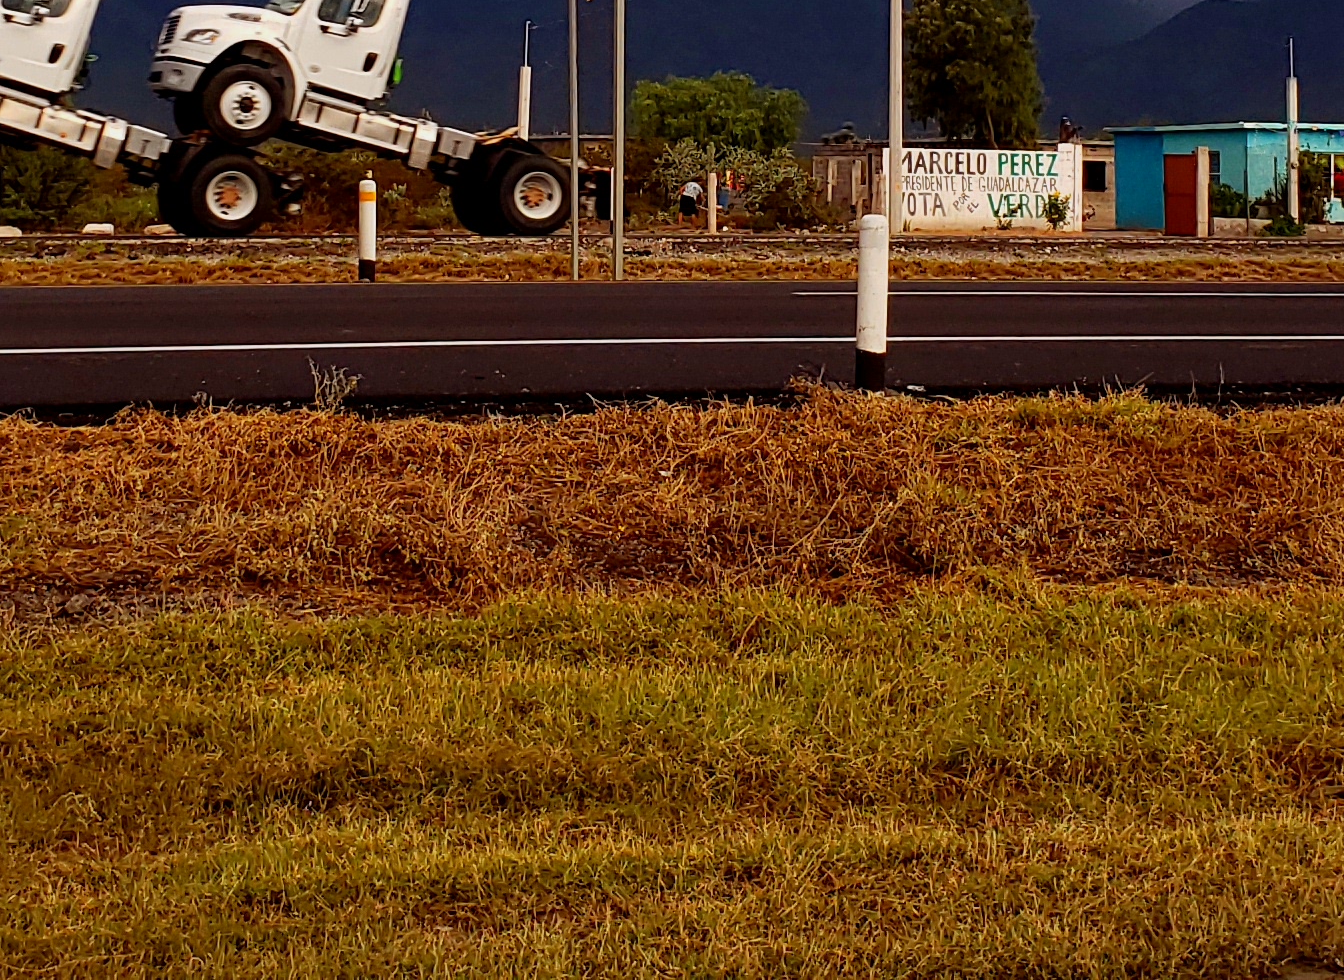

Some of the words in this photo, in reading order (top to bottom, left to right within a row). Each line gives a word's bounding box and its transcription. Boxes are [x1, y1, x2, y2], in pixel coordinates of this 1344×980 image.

[997, 152, 1059, 177] PEREZ
[961, 176, 974, 192] DE
[978, 176, 1058, 193] GUADALCAZAR
[901, 192, 947, 217] OTA
[952, 192, 971, 212] POR
[966, 202, 980, 214] EL
[987, 193, 1050, 219] VERD
